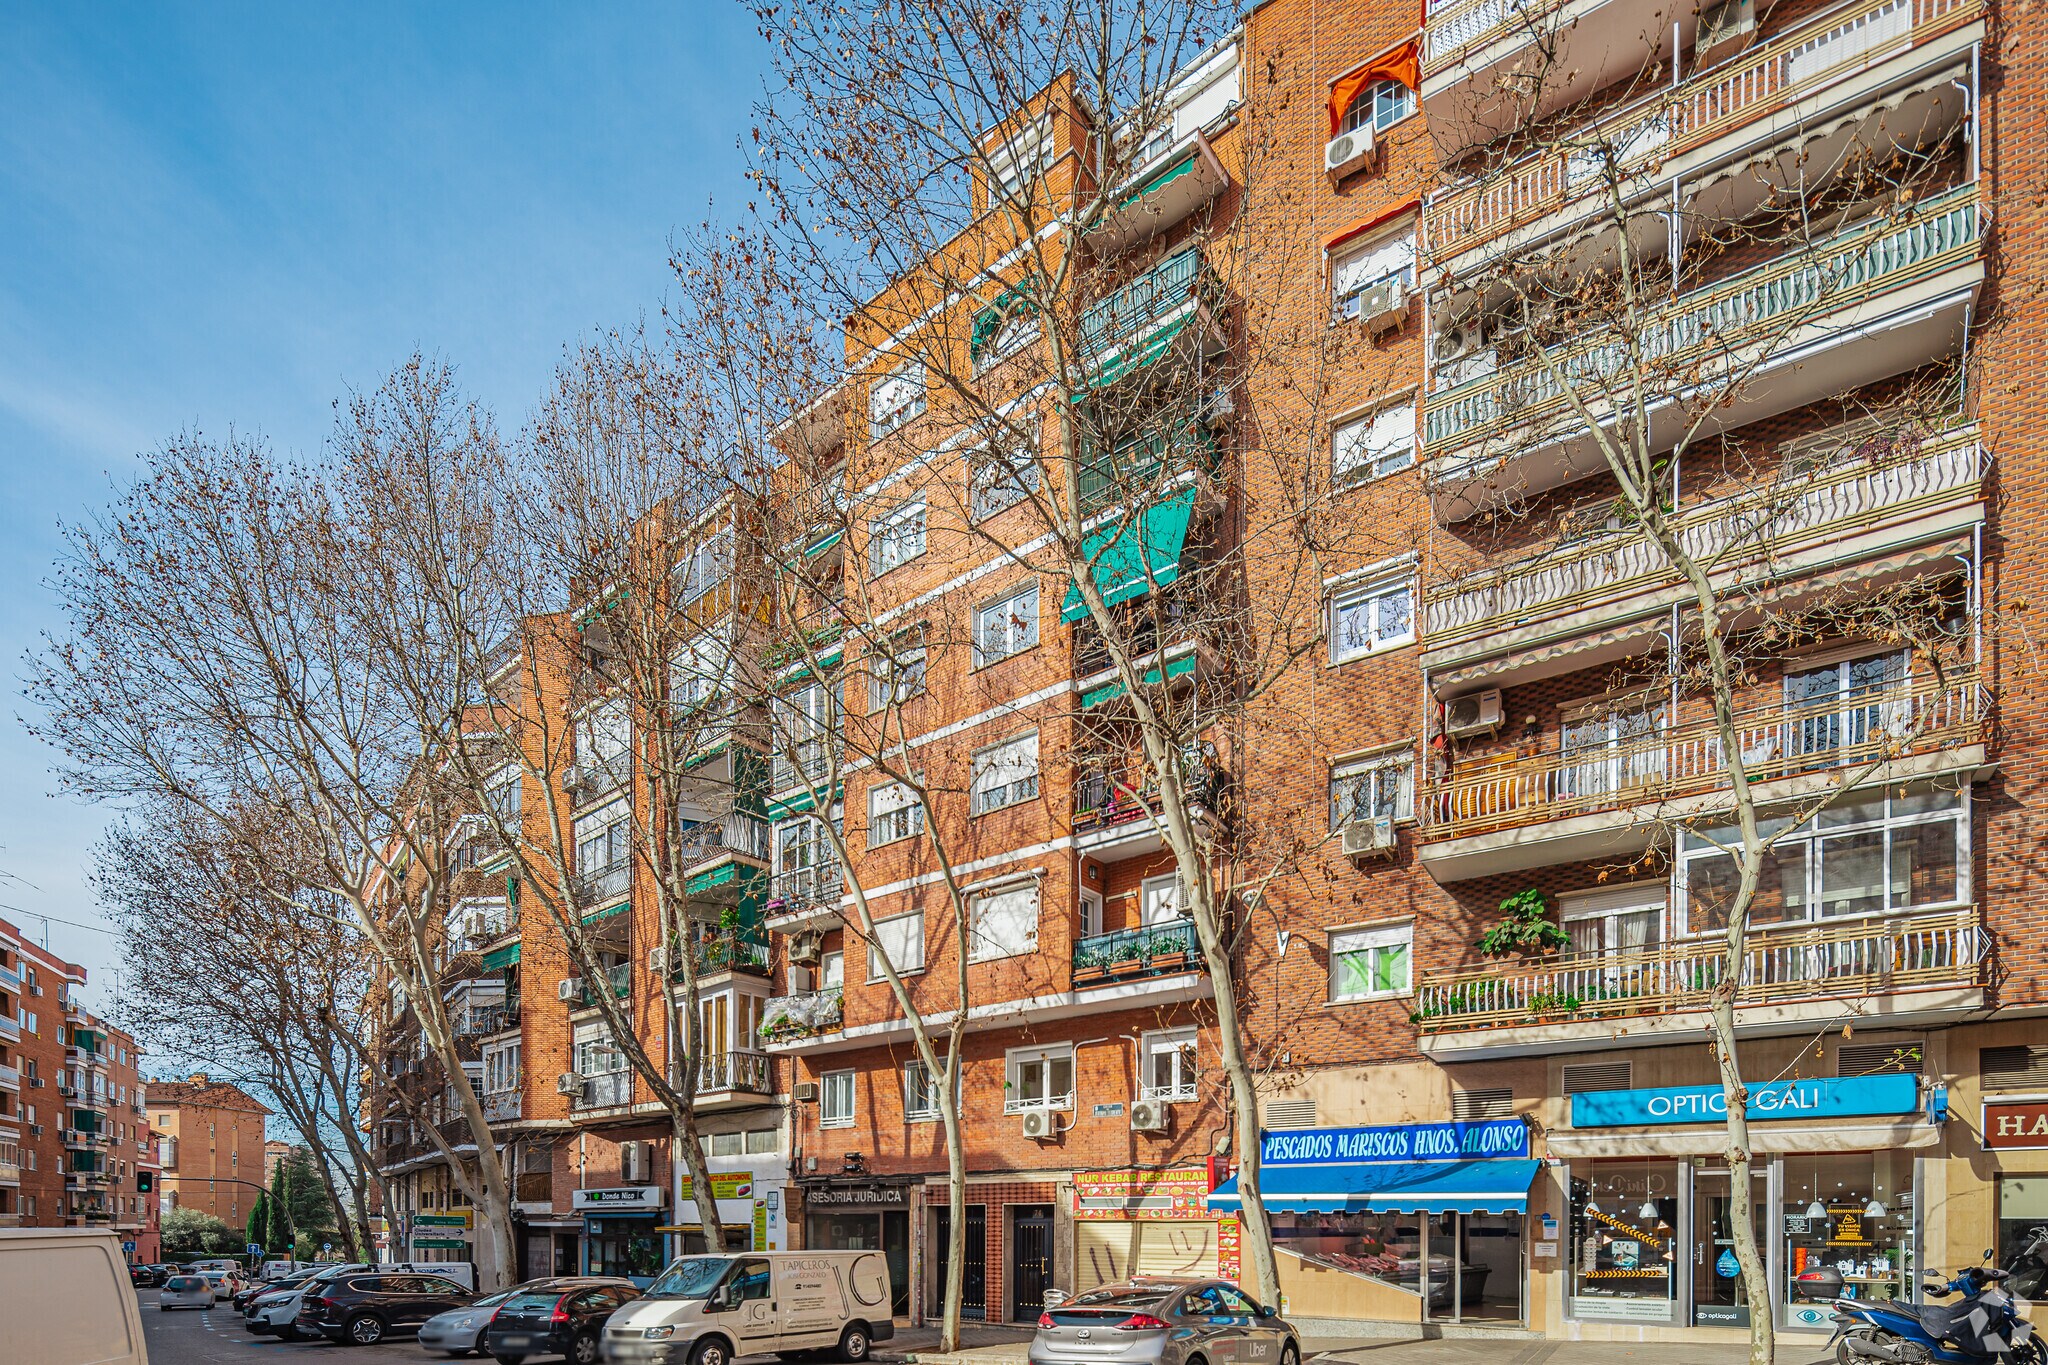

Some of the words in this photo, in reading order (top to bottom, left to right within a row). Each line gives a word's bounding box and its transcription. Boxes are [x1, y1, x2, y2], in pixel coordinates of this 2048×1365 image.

[1648, 1093, 1729, 1116] OPTIC
[1755, 1088, 1818, 1111] GALI
[1265, 1134, 1333, 1160] PESCADOS
[1336, 1131, 1409, 1158] MARISCOS
[1414, 1128, 1459, 1155] HNOS.
[1461, 1124, 1525, 1153] ALONSO
[1077, 1174, 1099, 1183] NUR
[1101, 1173, 1137, 1183] KEBAB
[1140, 1171, 1208, 1182] RESTAURAN
[602, 1192, 620, 1200] Donde
[621, 1191, 635, 1200] Nico
[806, 1191, 853, 1203] ASESORIA
[780, 1260, 831, 1270] TAPICEROS
[747, 1303, 765, 1321] JG
[1250, 1342, 1267, 1358] Uber
